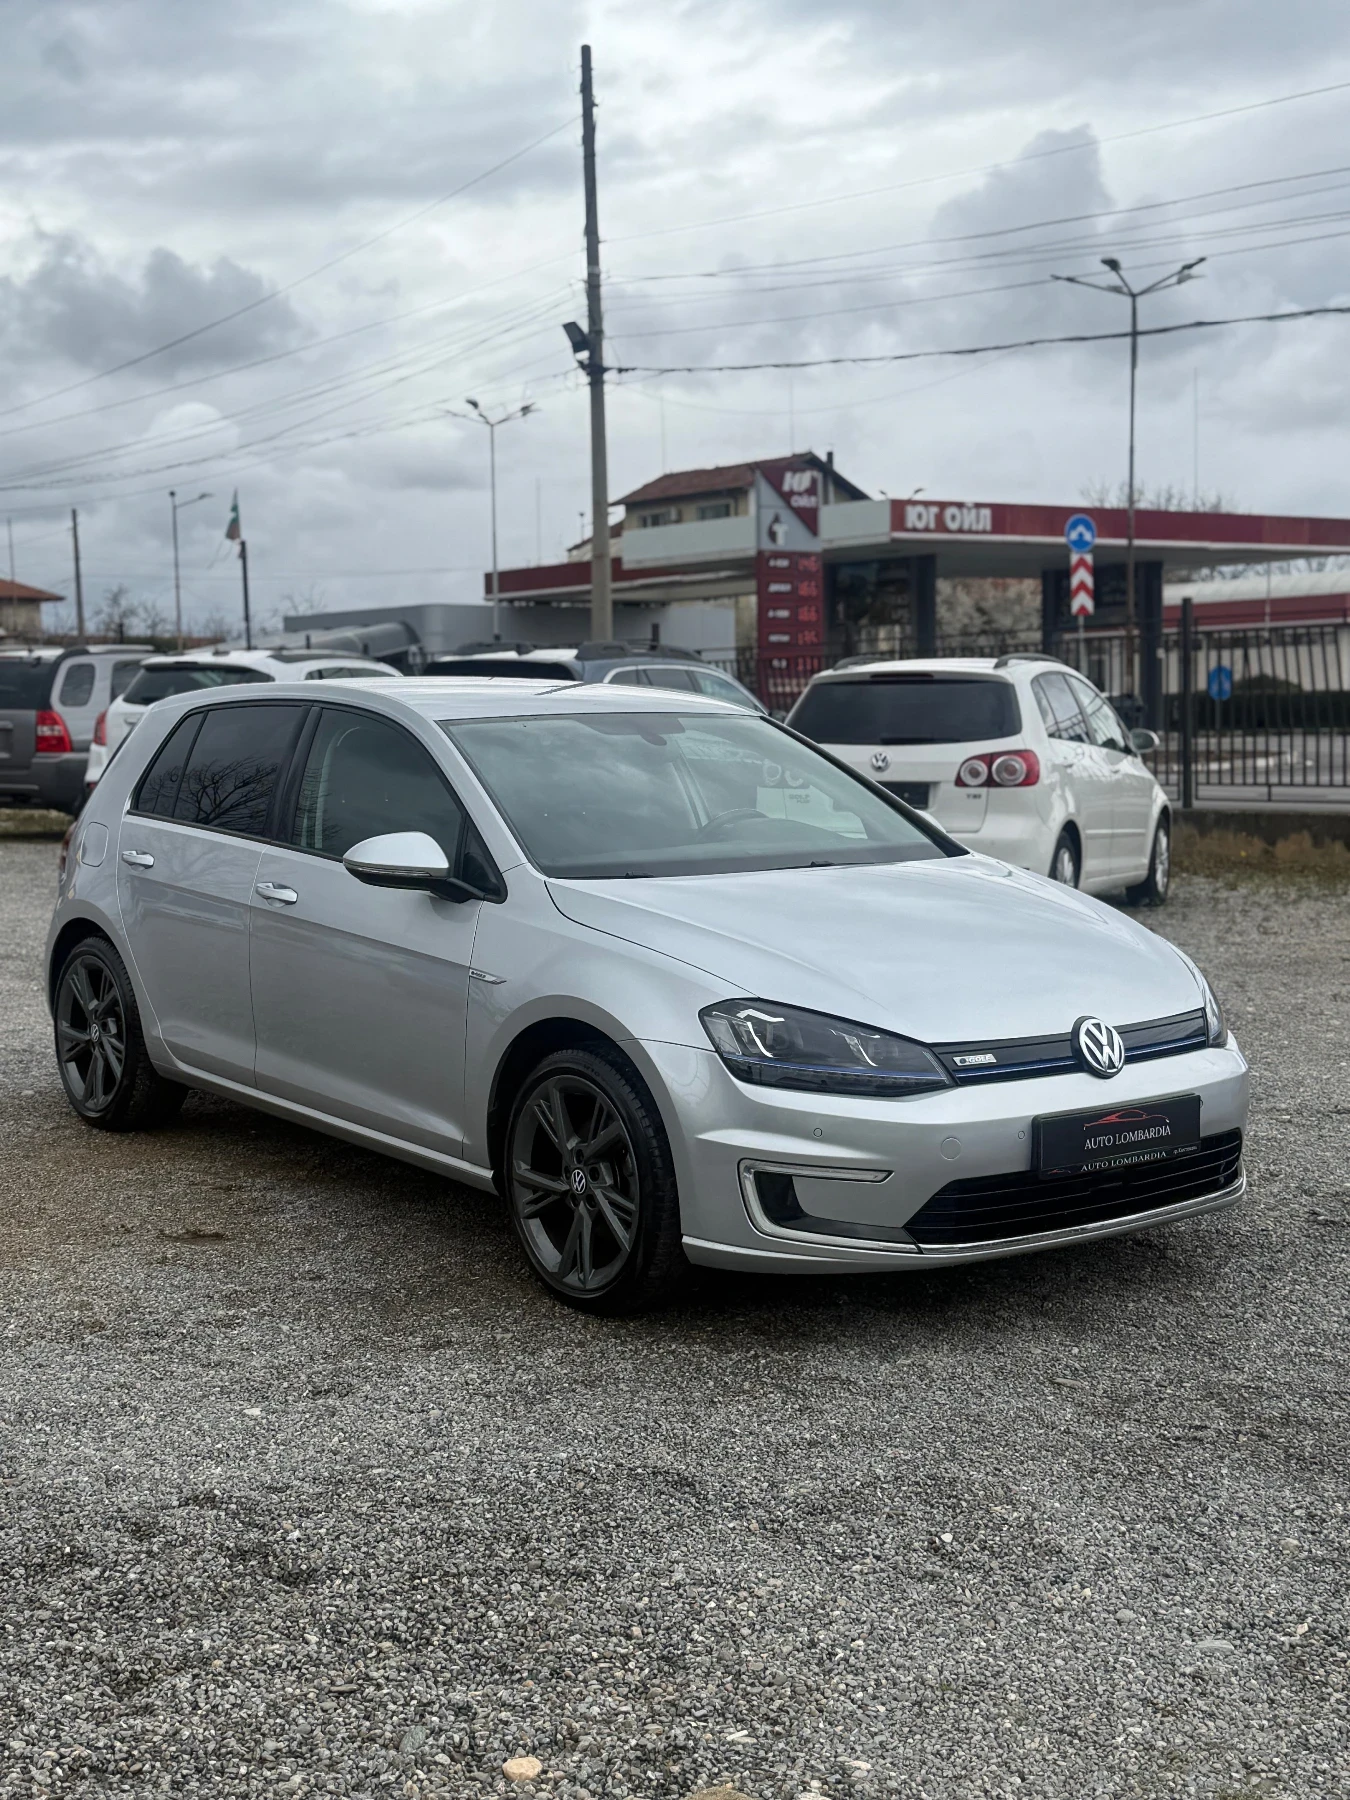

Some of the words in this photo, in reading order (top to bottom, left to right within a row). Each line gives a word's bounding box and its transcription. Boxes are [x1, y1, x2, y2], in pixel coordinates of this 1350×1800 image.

[905, 504, 939, 530] ЮГ
[944, 502, 992, 532] ОЙЛ
[1079, 1019, 1124, 1072] VW
[1084, 1136, 1113, 1150] AUTO
[1115, 1125, 1171, 1144] LOMBARDIA
[1081, 1161, 1109, 1172] AUTO
[1111, 1151, 1167, 1166] LOMBARDIA
